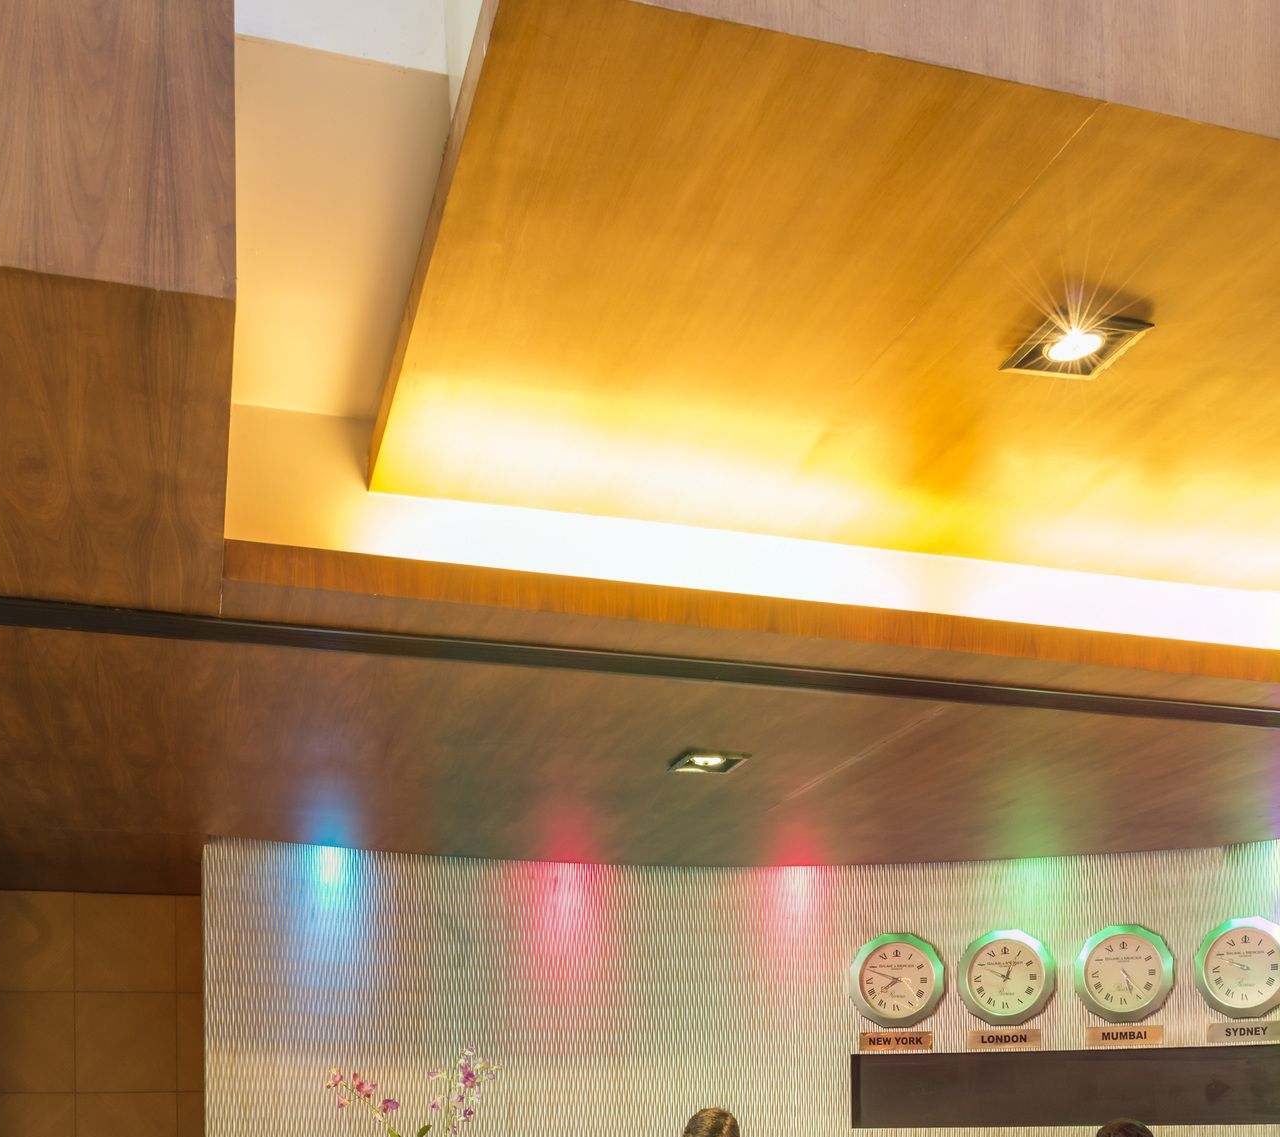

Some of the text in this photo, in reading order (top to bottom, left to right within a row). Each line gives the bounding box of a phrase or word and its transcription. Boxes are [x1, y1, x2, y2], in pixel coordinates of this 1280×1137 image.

[1101, 1030, 1148, 1041] MUMBAI
[1225, 1026, 1268, 1037] SYDNEY
[868, 1036, 923, 1046] NEW YORK
[981, 1034, 1027, 1044] LONDON
